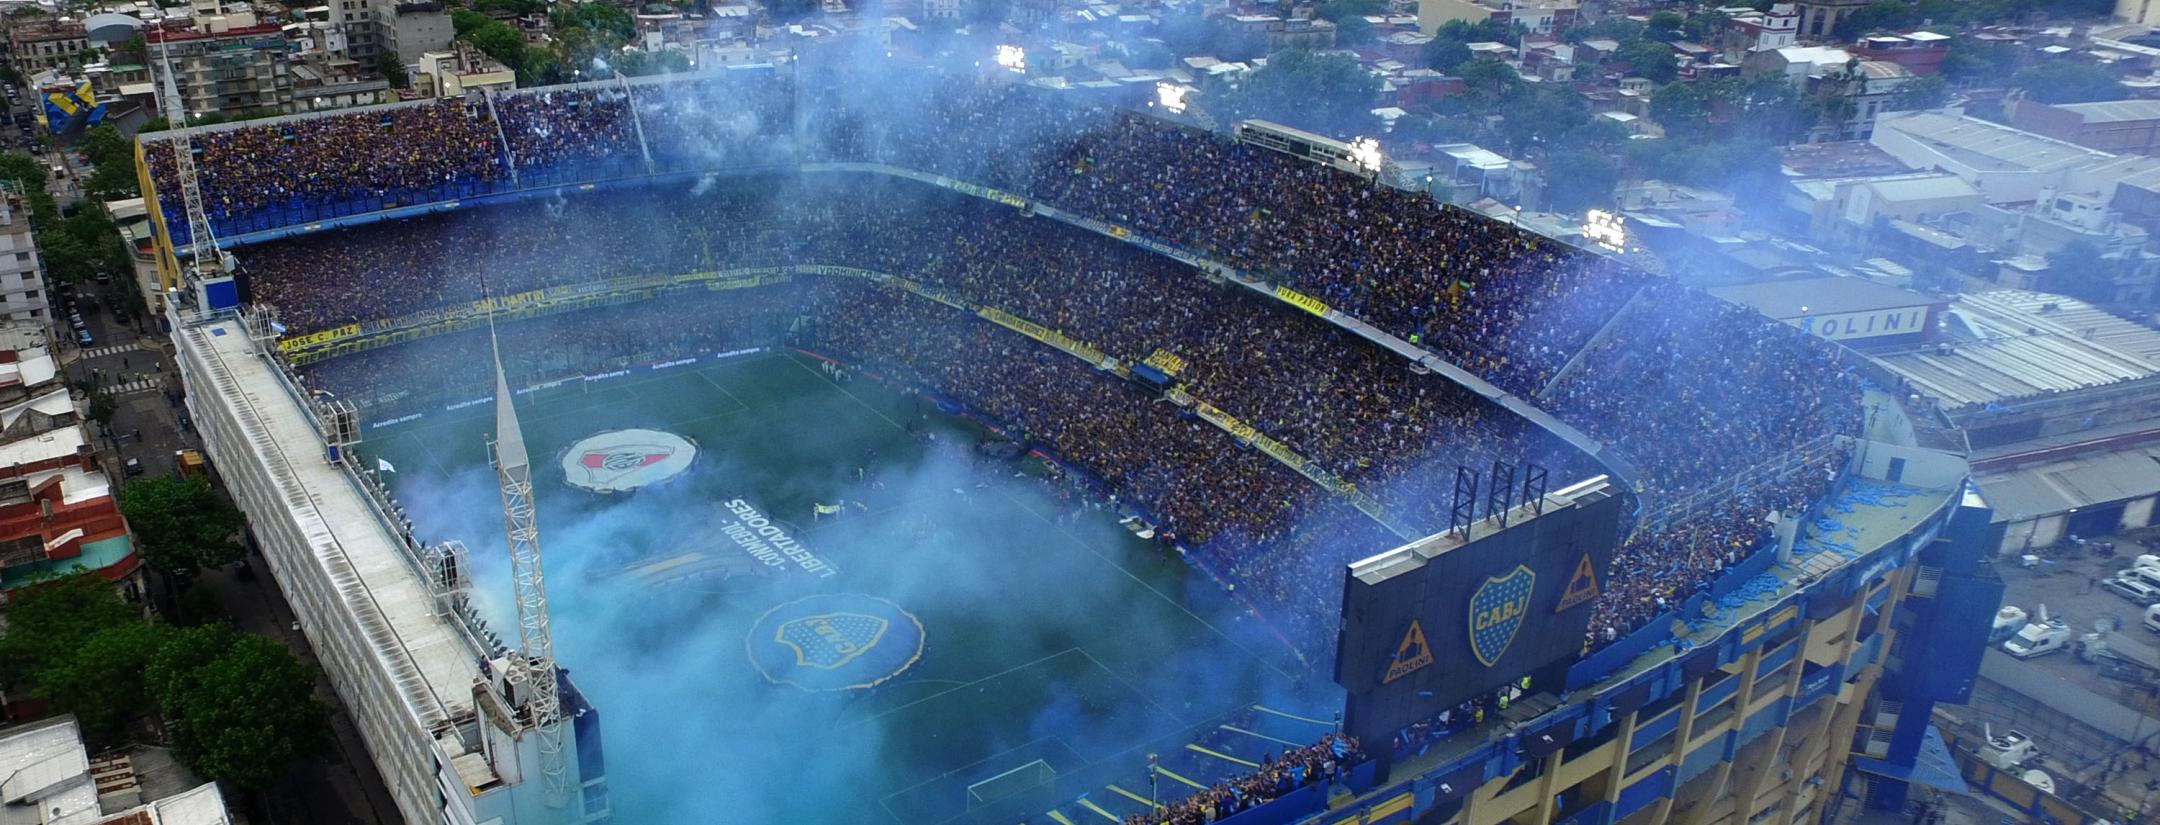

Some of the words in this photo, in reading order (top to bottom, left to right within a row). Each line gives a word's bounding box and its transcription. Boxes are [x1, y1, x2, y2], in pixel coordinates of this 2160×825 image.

[473, 296, 497, 313] SAN
[501, 289, 545, 307] MARTIN
[286, 335, 313, 351] JOSE
[333, 327, 353, 339] PAZ
[296, 343, 356, 364] SIEMPRE
[724, 498, 837, 579] LIBERTADORES
[1476, 596, 1525, 630] CABJ
[805, 618, 858, 654] CABJ
[1390, 655, 1430, 680] PAOLINI
